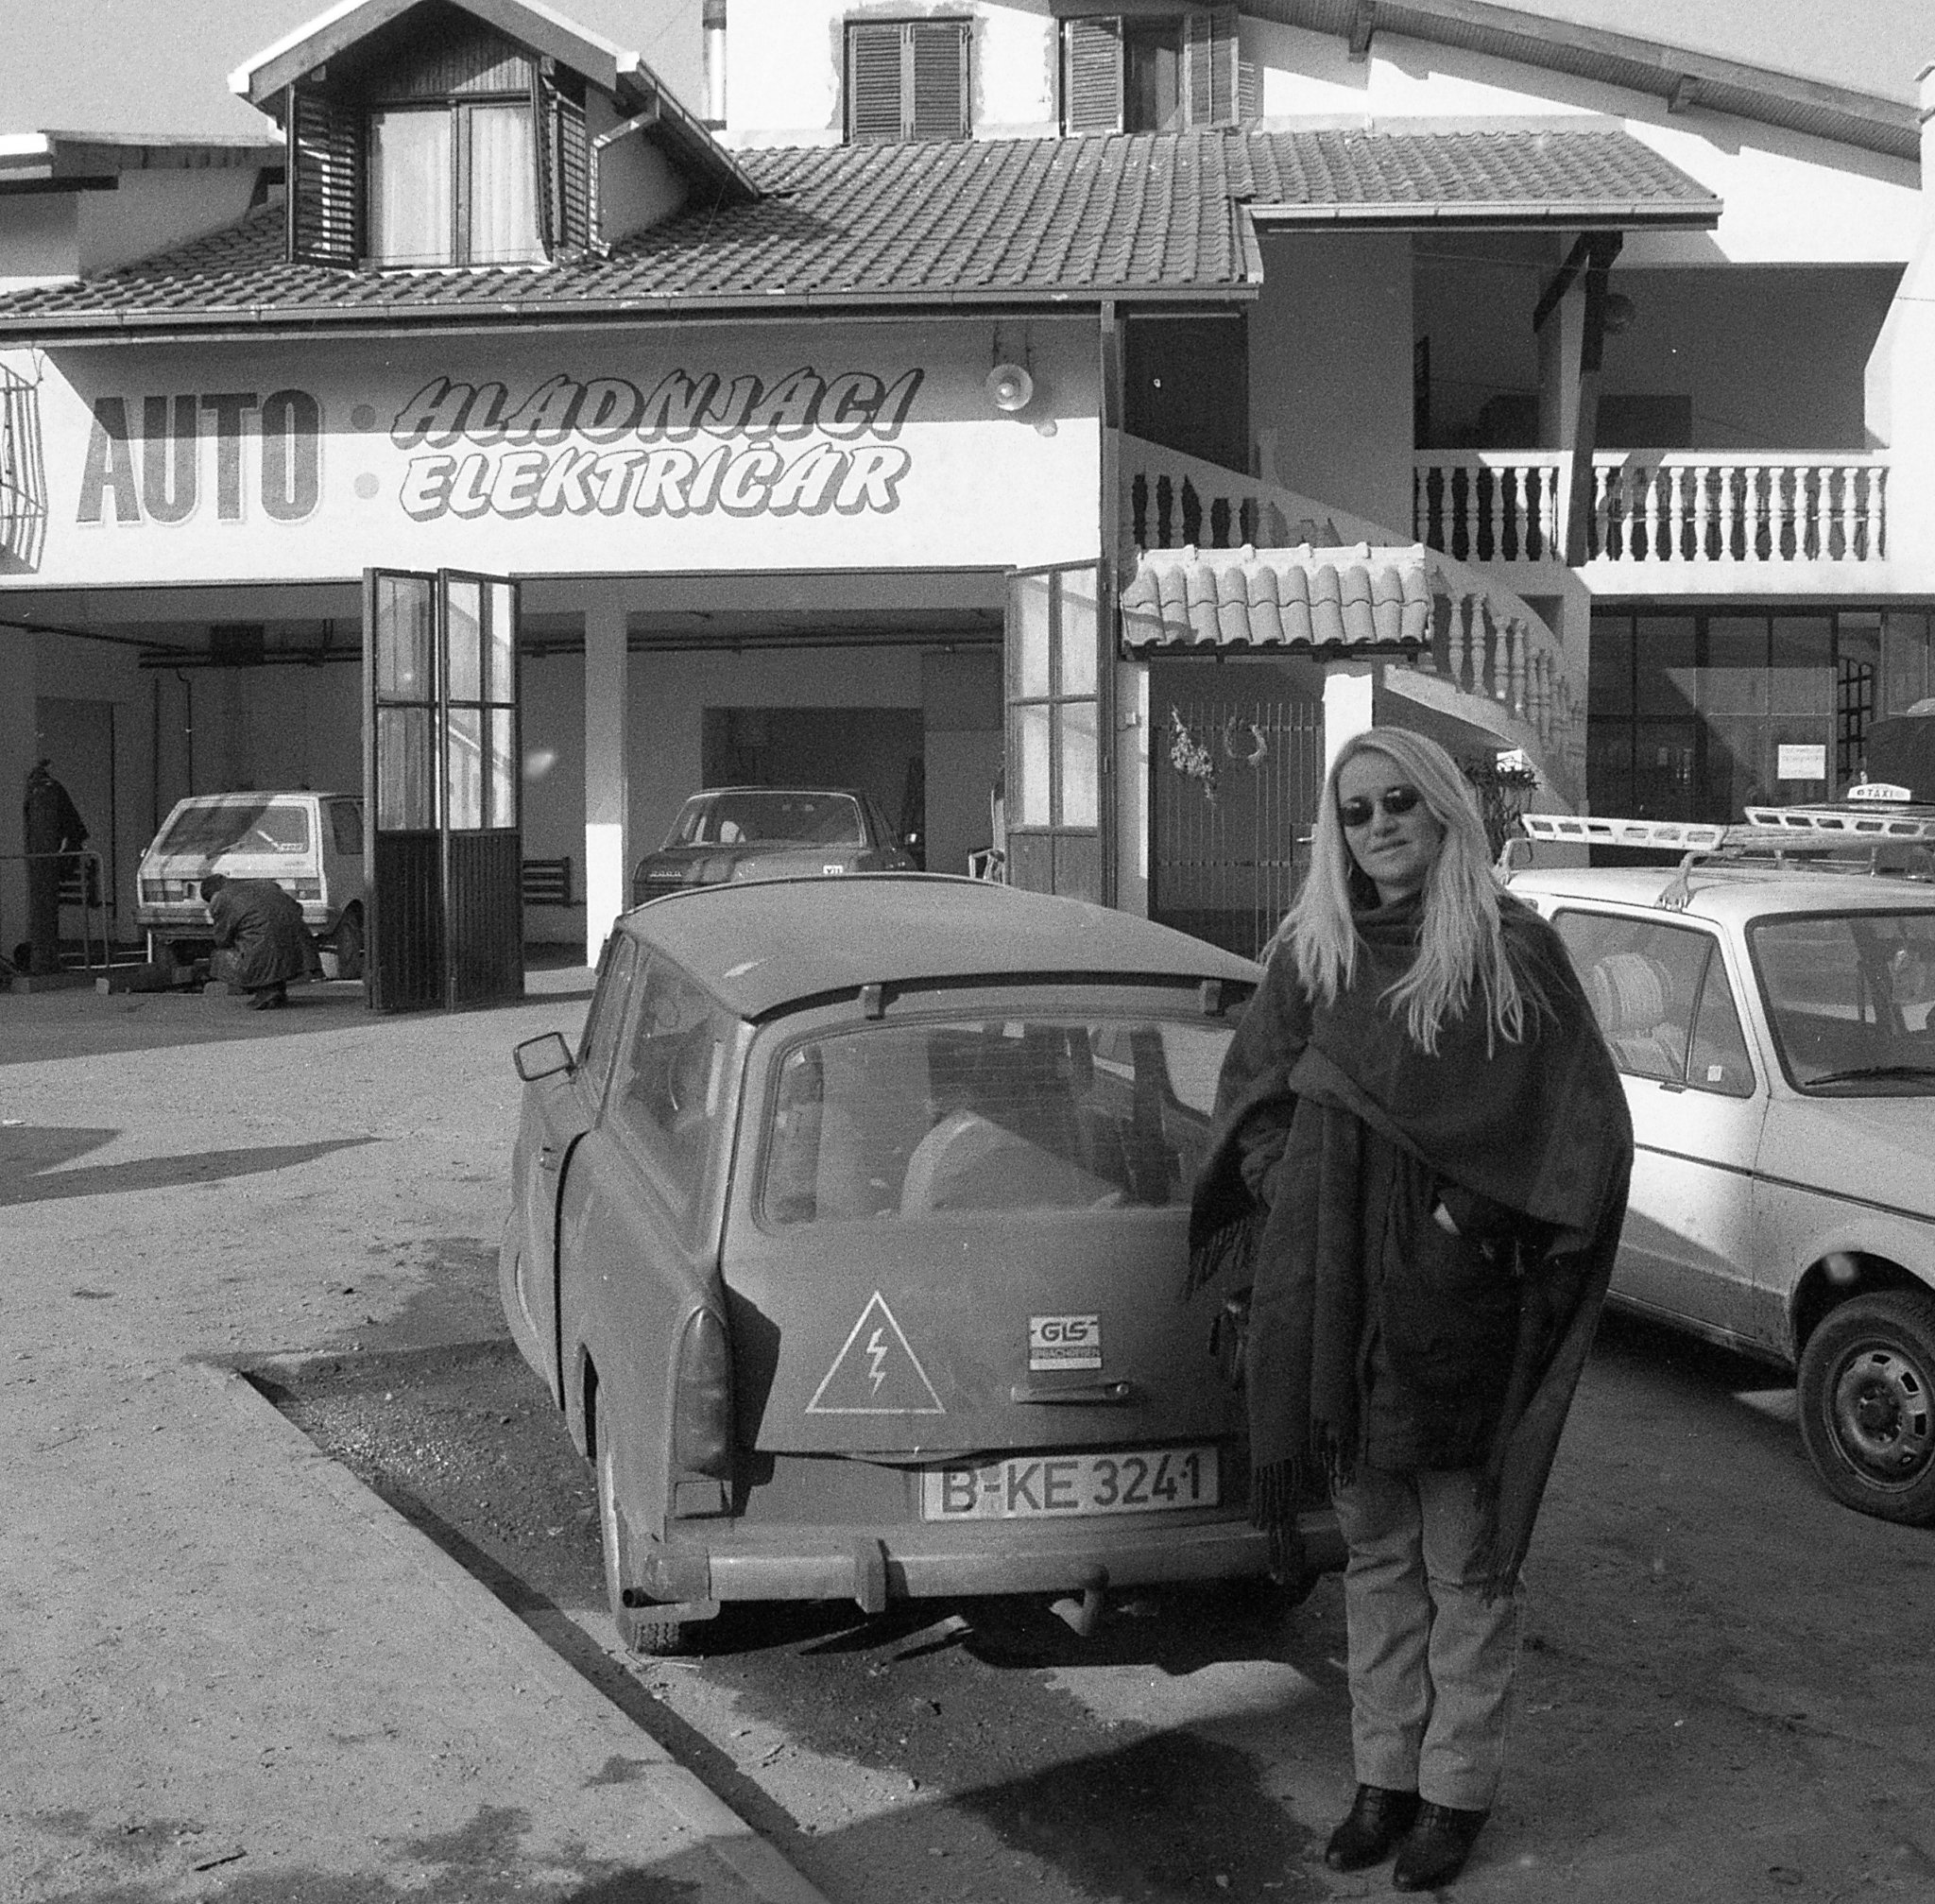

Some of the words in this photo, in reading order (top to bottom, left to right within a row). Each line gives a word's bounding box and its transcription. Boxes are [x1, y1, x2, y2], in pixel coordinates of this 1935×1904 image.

[390, 367, 925, 450] HLADNJACI
[77, 388, 322, 526] AUTO
[399, 441, 912, 522] ELEKTRIČAR
[1868, 789, 1893, 798] TAXI
[1041, 1322, 1088, 1342] GLS
[943, 1462, 1078, 1512] B-KE
[1093, 1451, 1201, 1507] 3241
